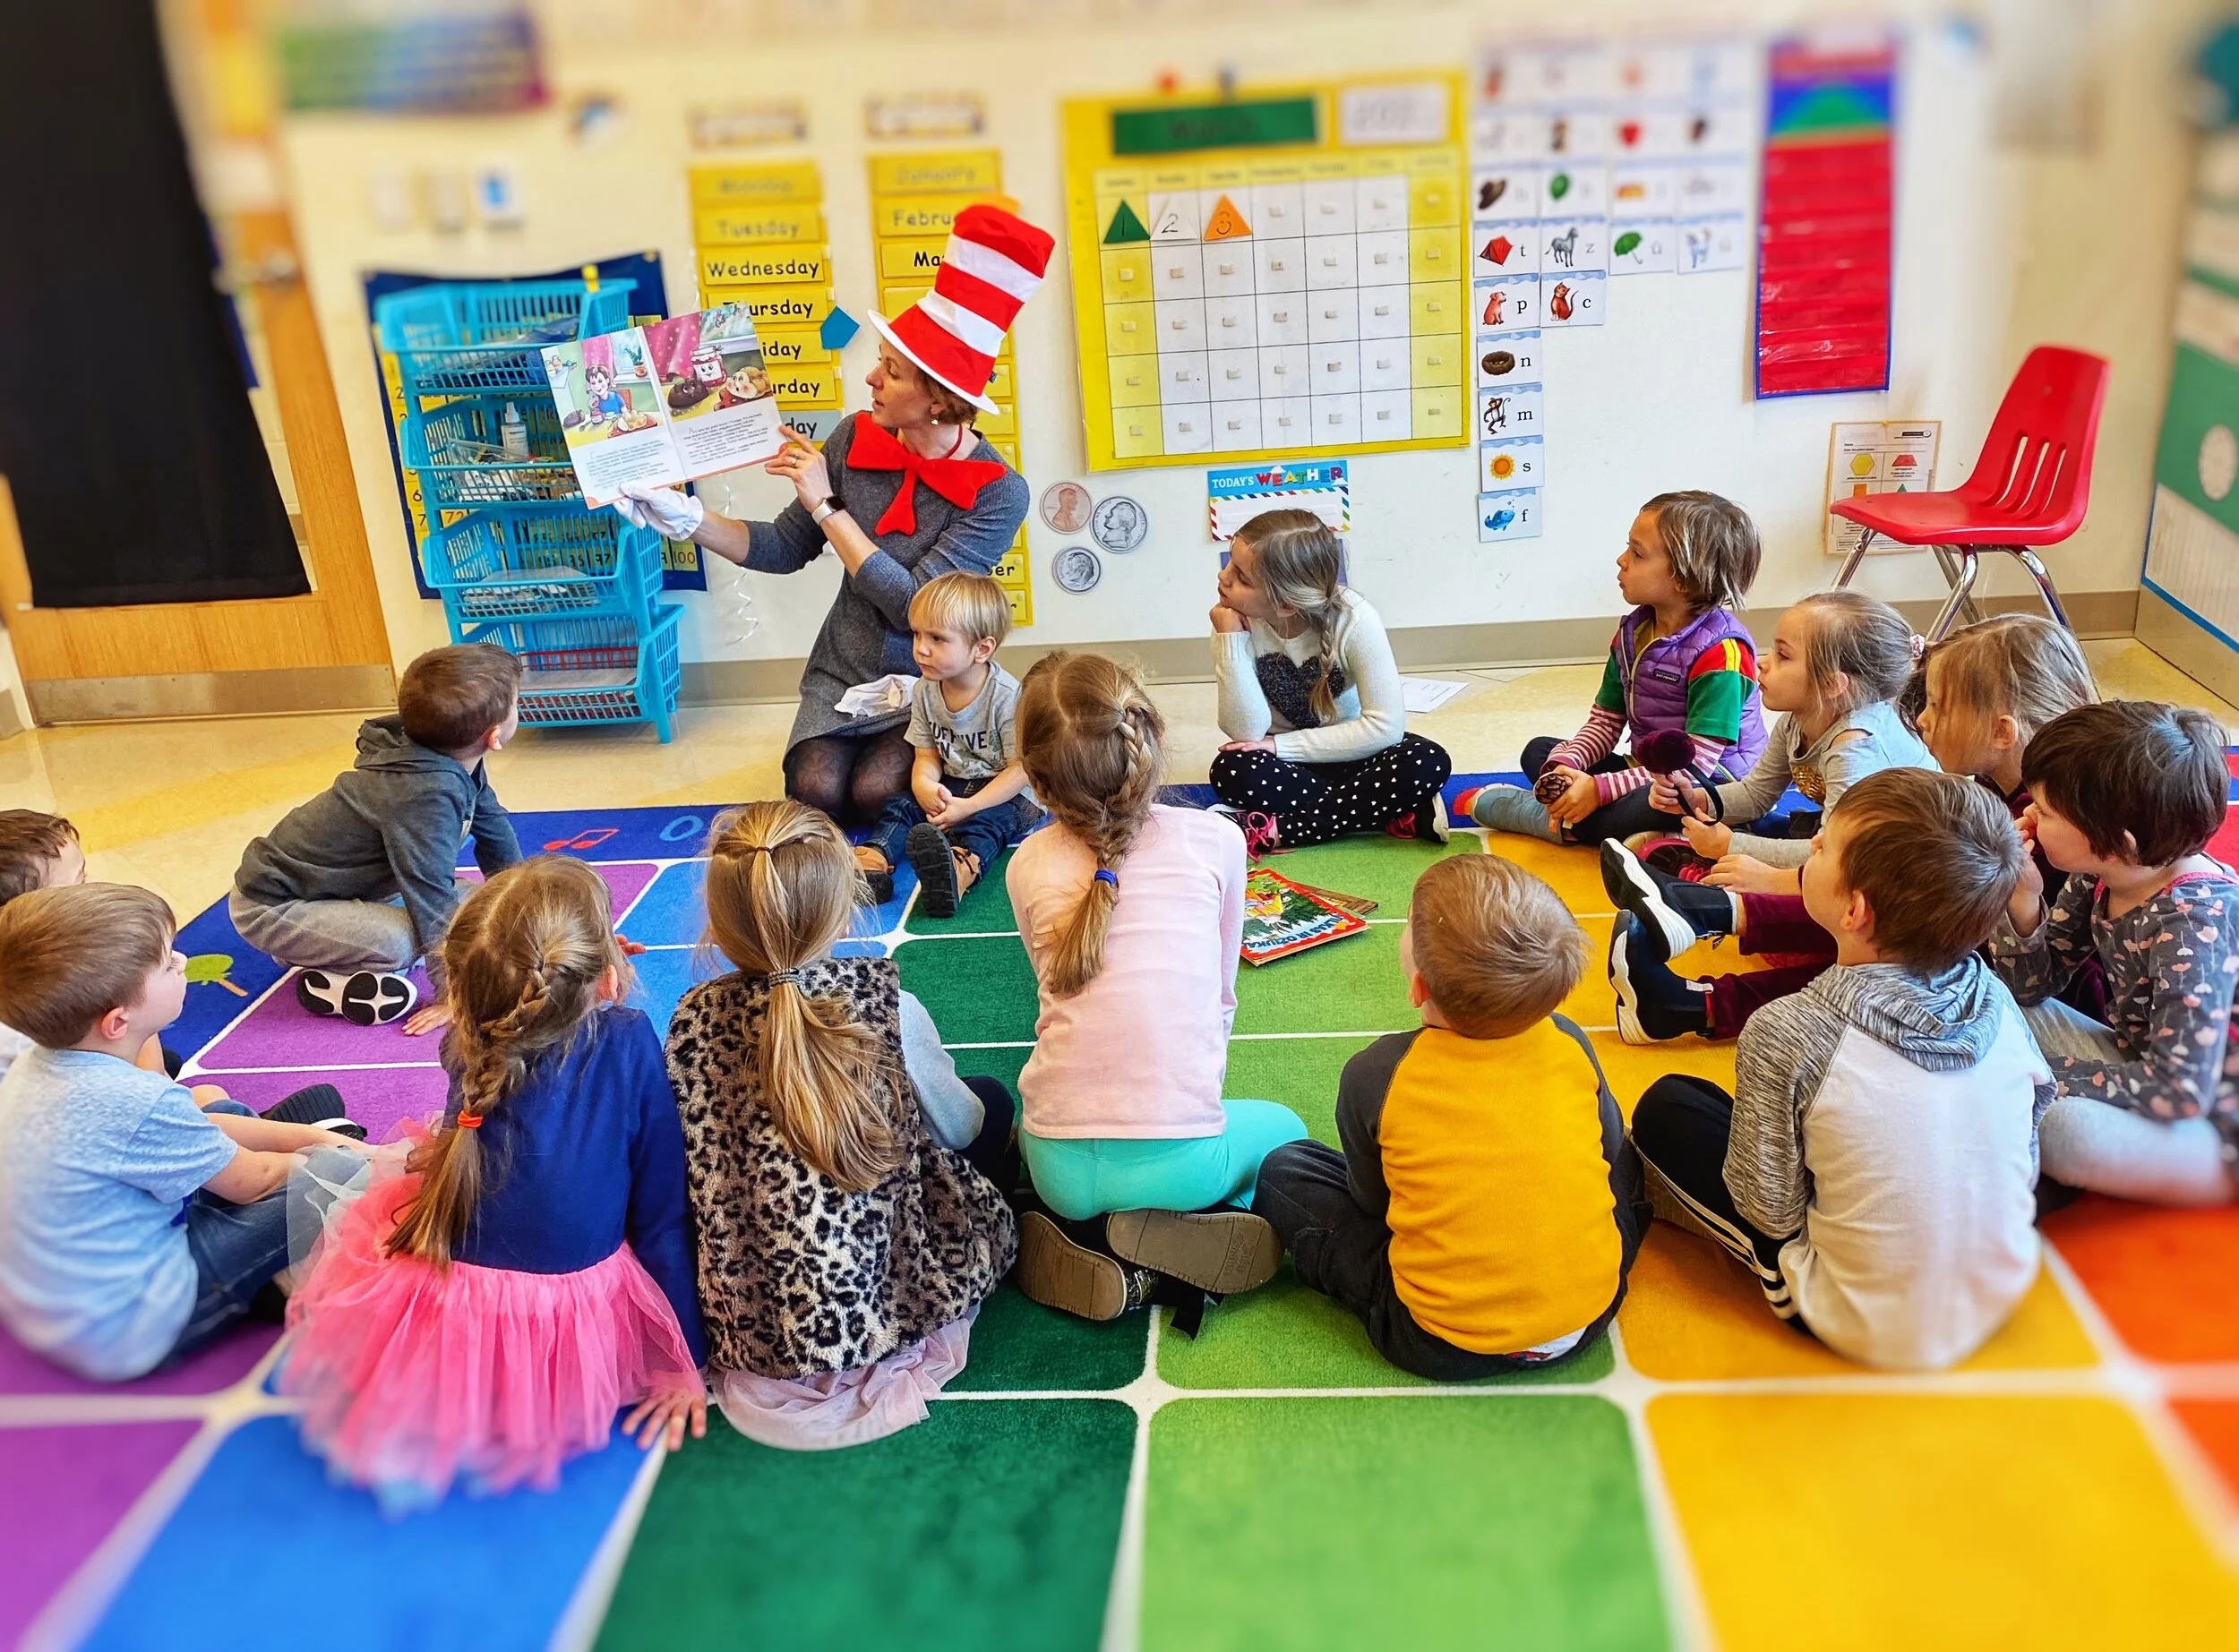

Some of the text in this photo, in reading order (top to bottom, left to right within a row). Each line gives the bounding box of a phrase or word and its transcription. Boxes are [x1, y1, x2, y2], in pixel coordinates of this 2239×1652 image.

[893, 210, 957, 227] Febru
[1120, 213, 1126, 237] 1
[1162, 212, 1180, 234] 2
[1216, 210, 1232, 235] 3
[718, 218, 800, 239] Tuesday
[1519, 243, 1527, 257] t
[1585, 243, 1595, 253] z
[708, 259, 819, 278] Wednesday
[723, 299, 813, 319] ursday
[1517, 298, 1528, 314] p
[1582, 297, 1591, 309] c
[762, 341, 802, 360] iday
[1520, 355, 1531, 367] n
[395, 387, 404, 399] 2
[1517, 409, 1533, 421] m
[1522, 461, 1531, 473] s
[1212, 467, 1343, 489] TODAY'S WEATHER
[412, 489, 422, 501] 6
[417, 514, 426, 526] 7
[1521, 509, 1529, 522] f
[673, 552, 696, 564] 100
